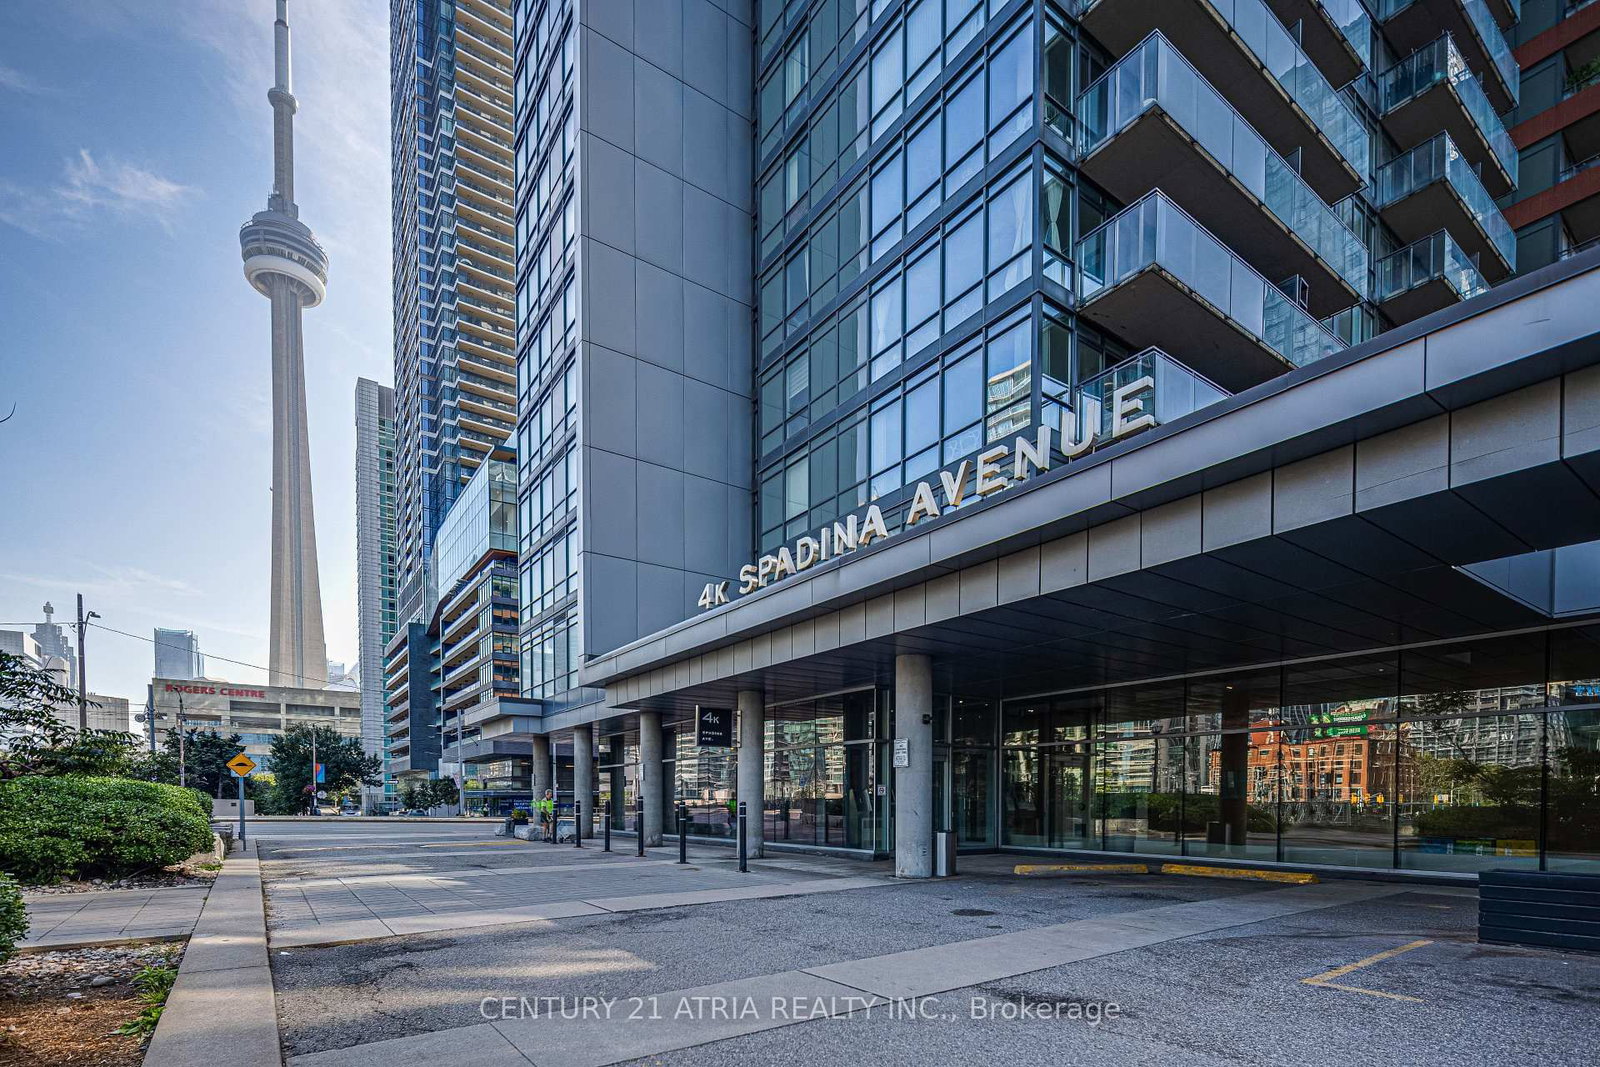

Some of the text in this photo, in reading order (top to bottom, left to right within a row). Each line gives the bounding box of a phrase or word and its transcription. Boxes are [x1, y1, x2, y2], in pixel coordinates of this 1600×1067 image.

[698, 376, 1155, 609] 4K SPADINA AVENUE
[165, 684, 265, 698] ROGERS CENTRE
[702, 711, 720, 724] 4K
